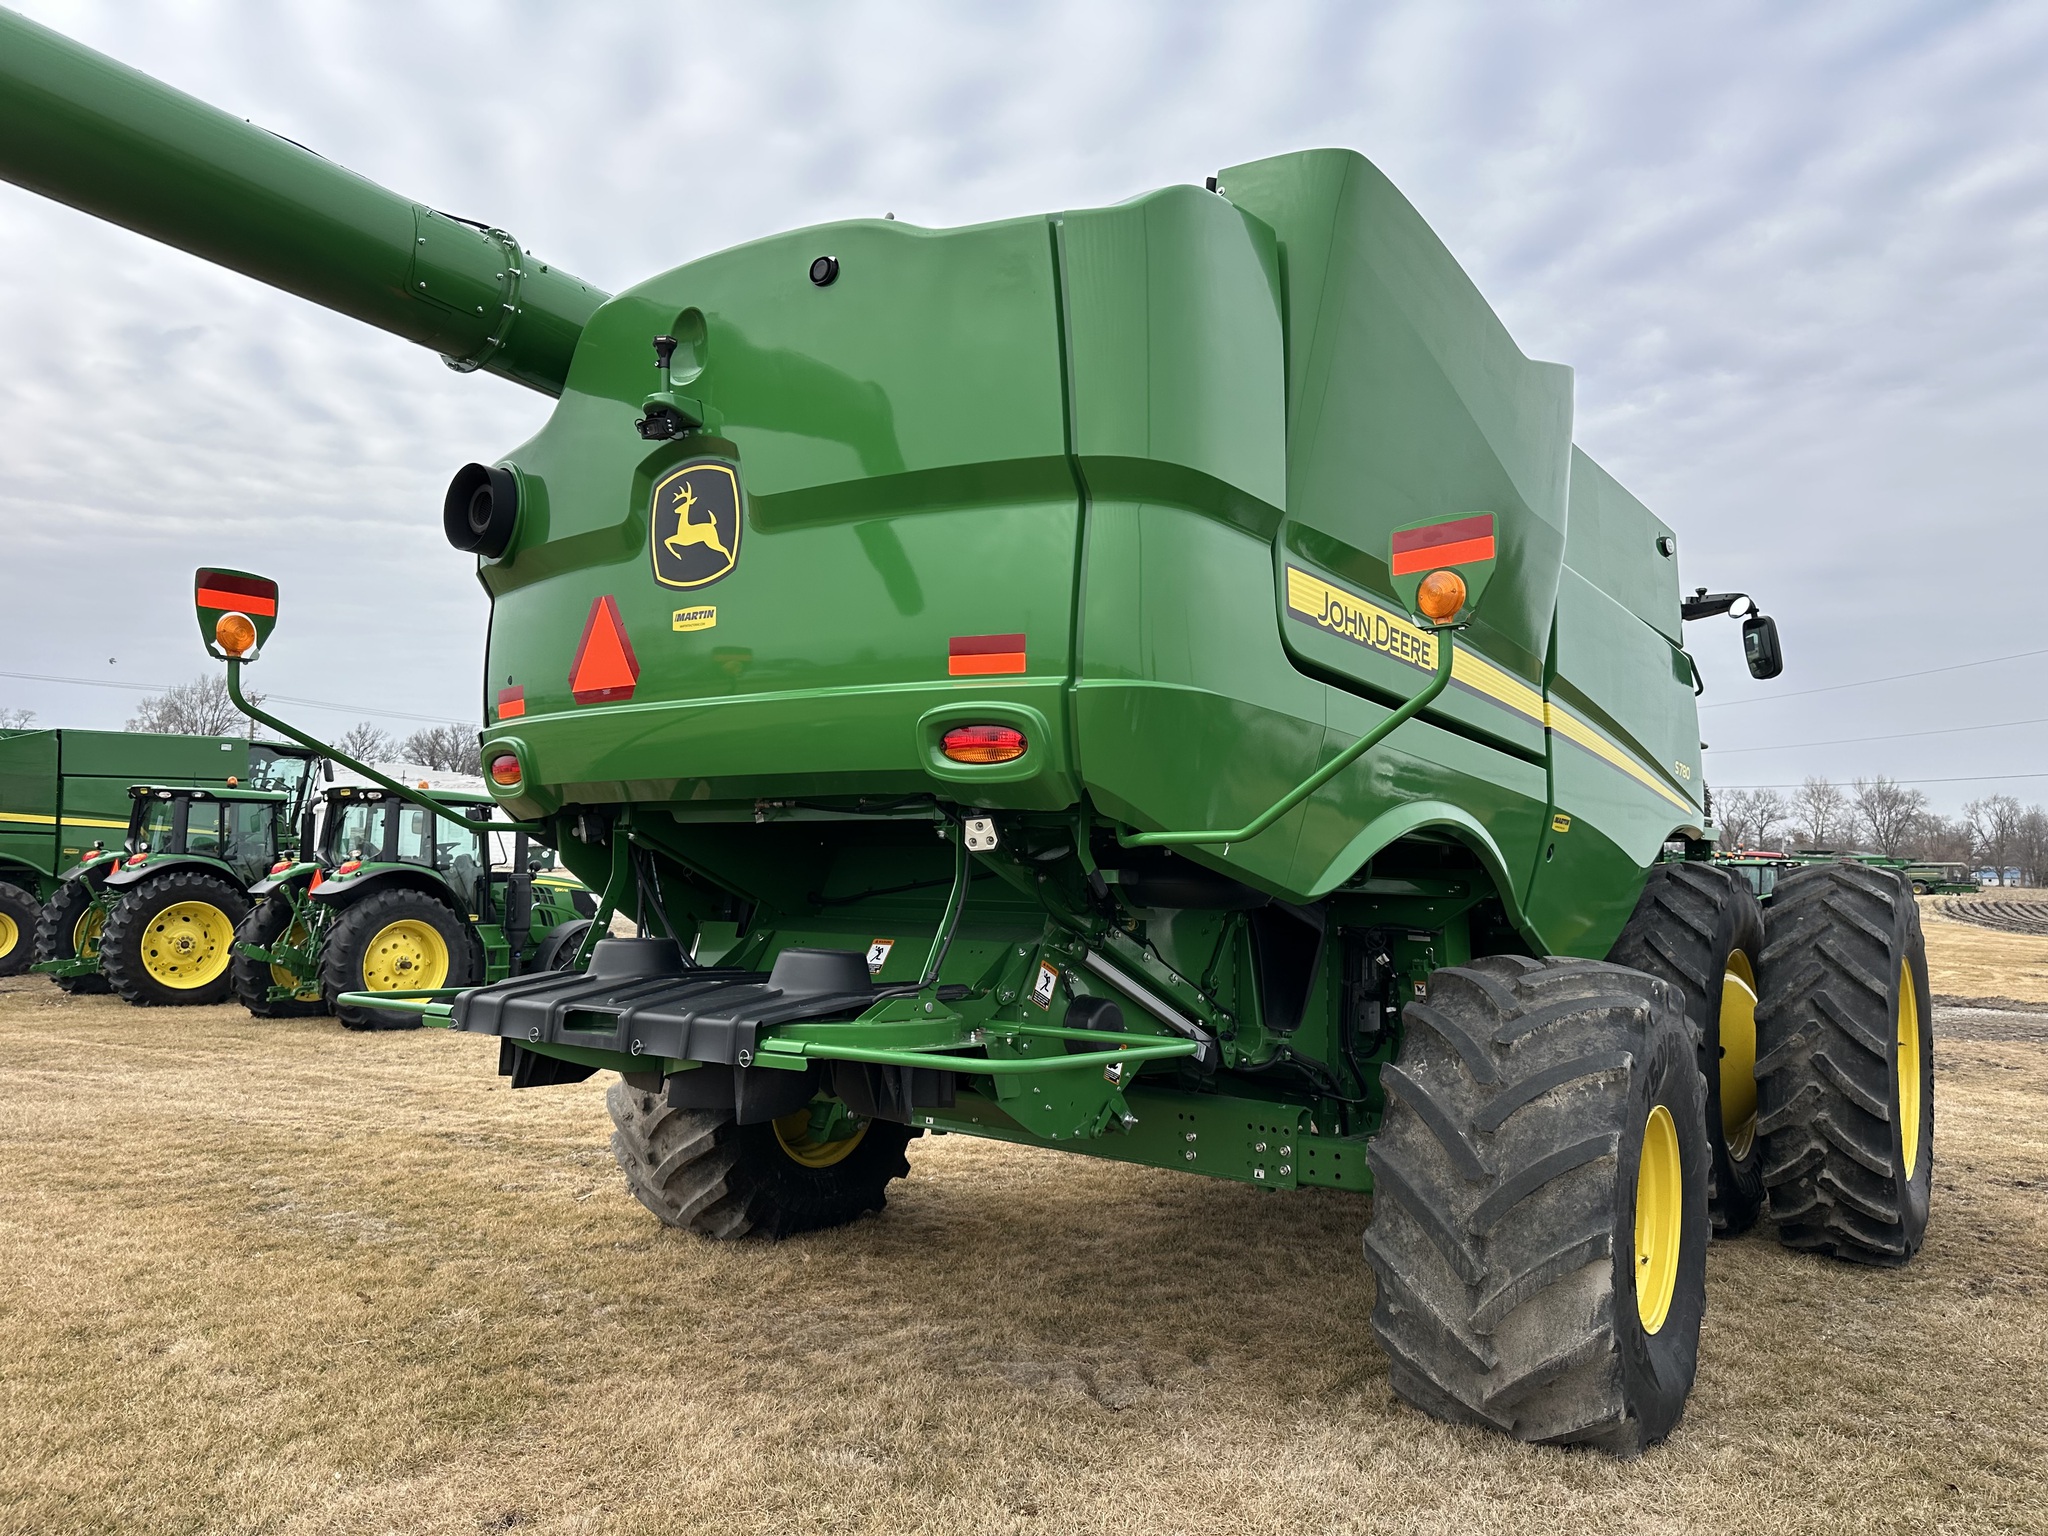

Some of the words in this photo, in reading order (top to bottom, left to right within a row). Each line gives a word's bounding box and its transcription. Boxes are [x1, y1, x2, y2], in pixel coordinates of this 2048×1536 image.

[675, 609, 715, 622] MARTIN
[1317, 591, 1371, 641] JOHN
[1376, 614, 1431, 667] DEERE
[1675, 760, 1690, 780] S780
